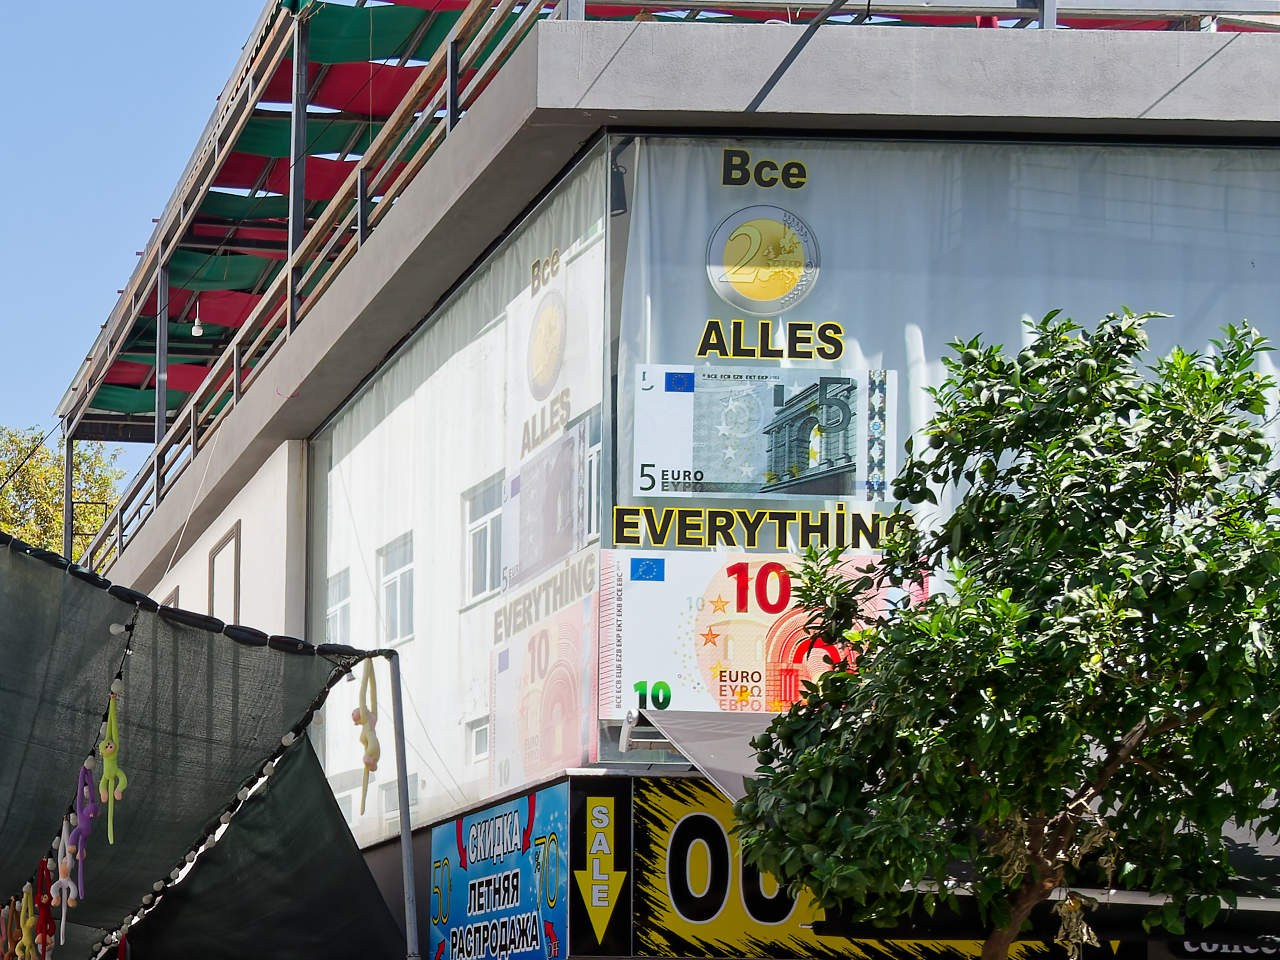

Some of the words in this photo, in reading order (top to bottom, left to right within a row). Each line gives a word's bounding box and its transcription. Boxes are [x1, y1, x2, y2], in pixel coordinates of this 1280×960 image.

[722, 148, 808, 189] Все
[696, 319, 846, 361] ALLES
[520, 388, 570, 460] ALLES
[639, 463, 656, 491] 5
[661, 469, 705, 482] EURO
[726, 562, 791, 614] 10
[528, 628, 550, 684] 10
[719, 669, 762, 683] EURO
[632, 680, 672, 710] 10
[469, 810, 521, 864] СКИДКА
[589, 805, 612, 907] SALE
[431, 858, 451, 926] 50
[467, 868, 520, 917] ЛЕТНЯЯ
